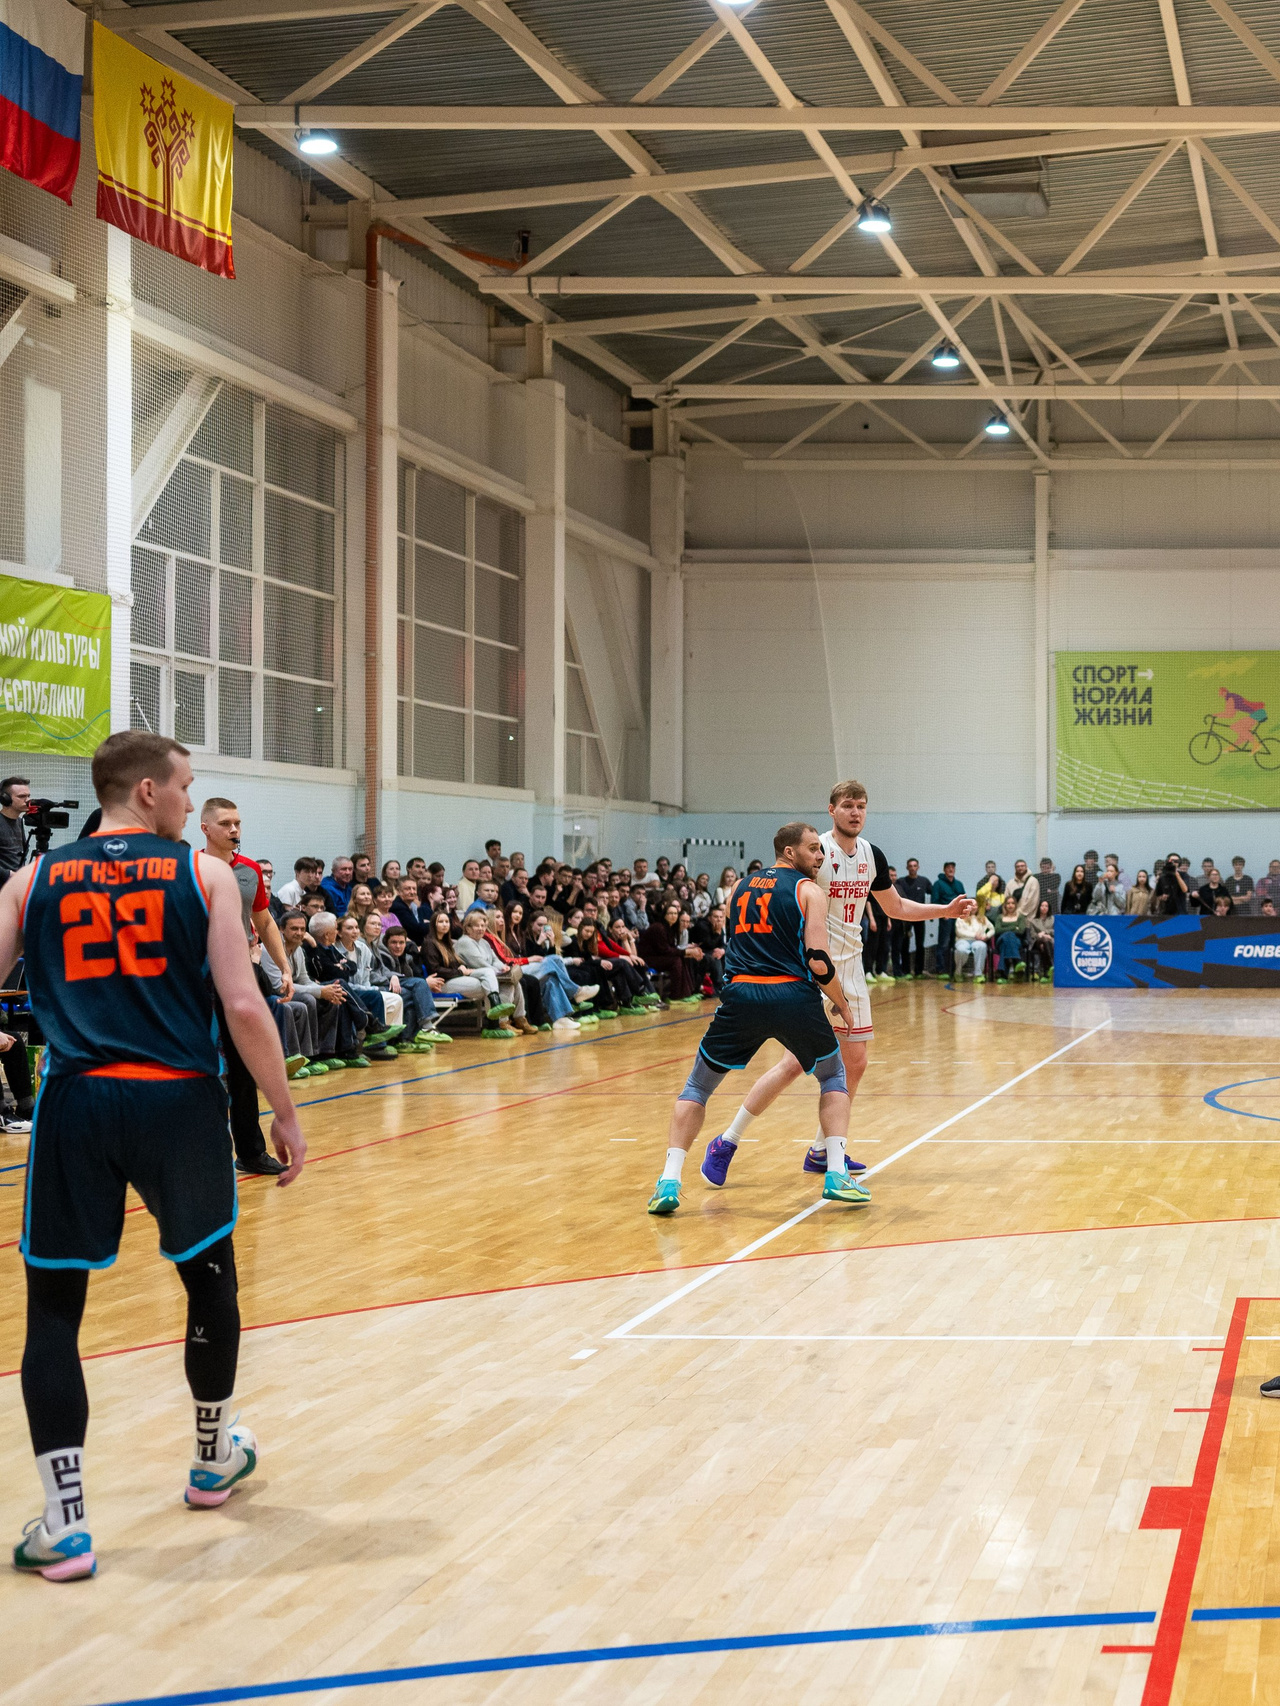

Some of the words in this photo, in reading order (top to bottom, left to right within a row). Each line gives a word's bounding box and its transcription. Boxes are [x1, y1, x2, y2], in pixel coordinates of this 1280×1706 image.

[31, 627, 101, 670] КУЛЬТУРЫ
[1072, 665, 1138, 684] СПОРТ
[1073, 686, 1152, 705] НОРМА
[1074, 707, 1152, 726] ЖИЗНИ
[734, 891, 773, 935] 11
[843, 903, 856, 923] 13
[59, 889, 168, 982] 22
